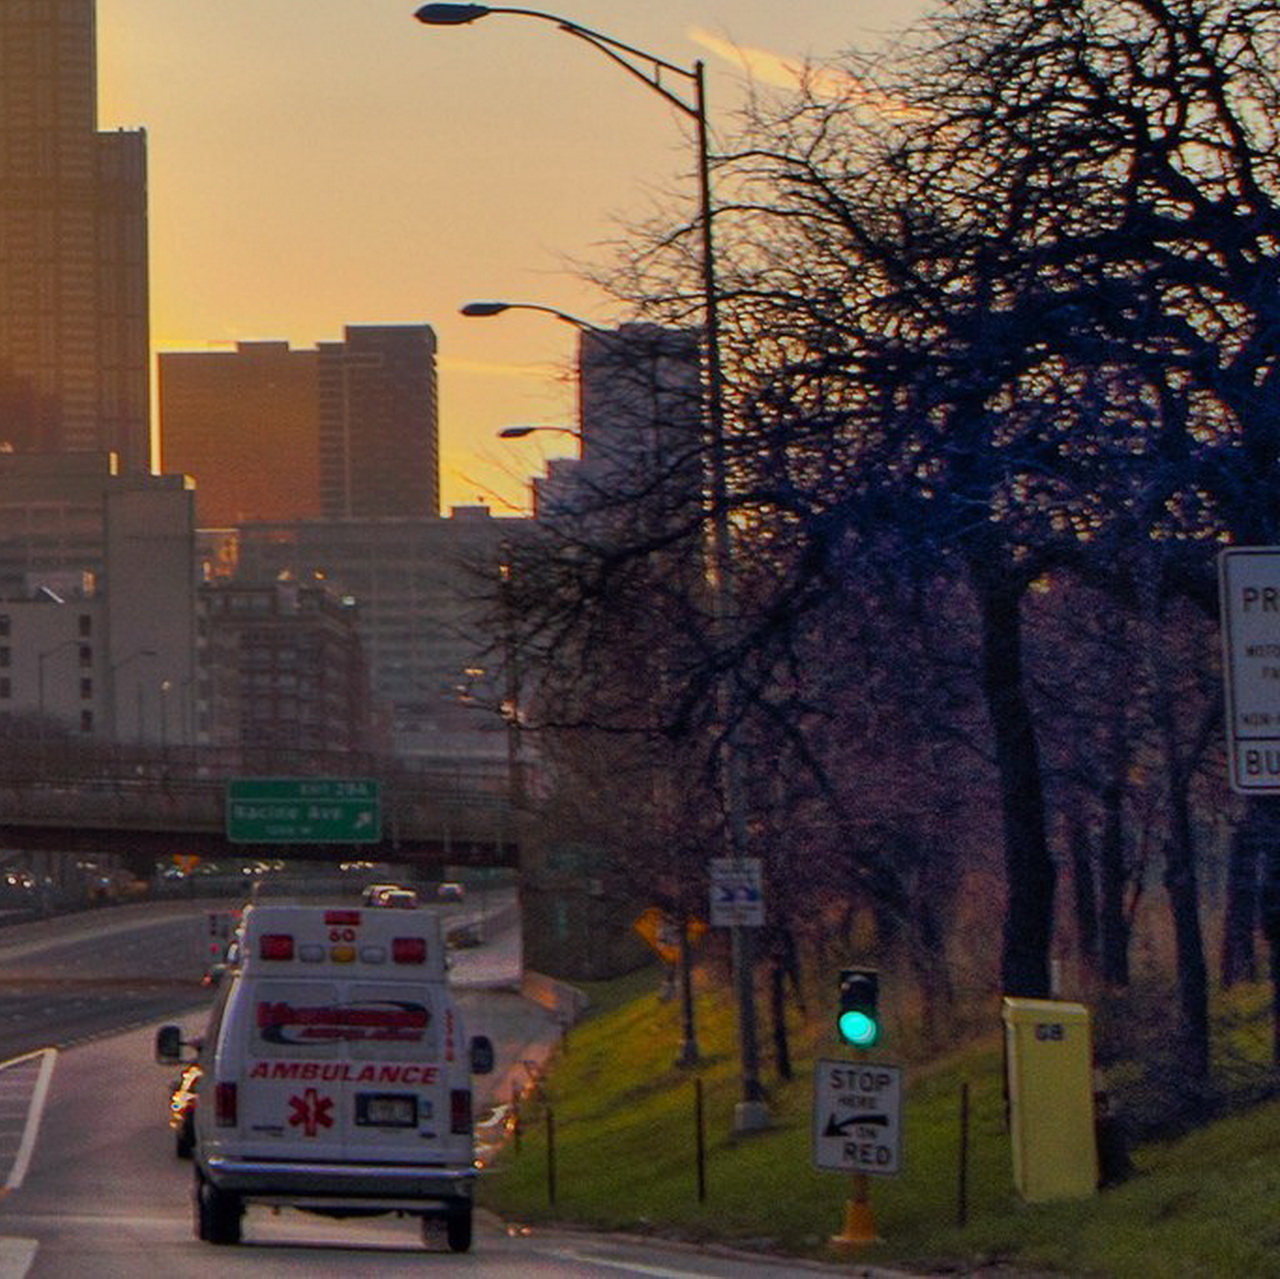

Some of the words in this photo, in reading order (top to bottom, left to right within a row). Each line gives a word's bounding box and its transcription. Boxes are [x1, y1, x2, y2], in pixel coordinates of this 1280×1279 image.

[249, 1061, 441, 1085] AMBULANCE
[830, 1068, 892, 1093] STOP
[842, 1142, 892, 1166] RED
